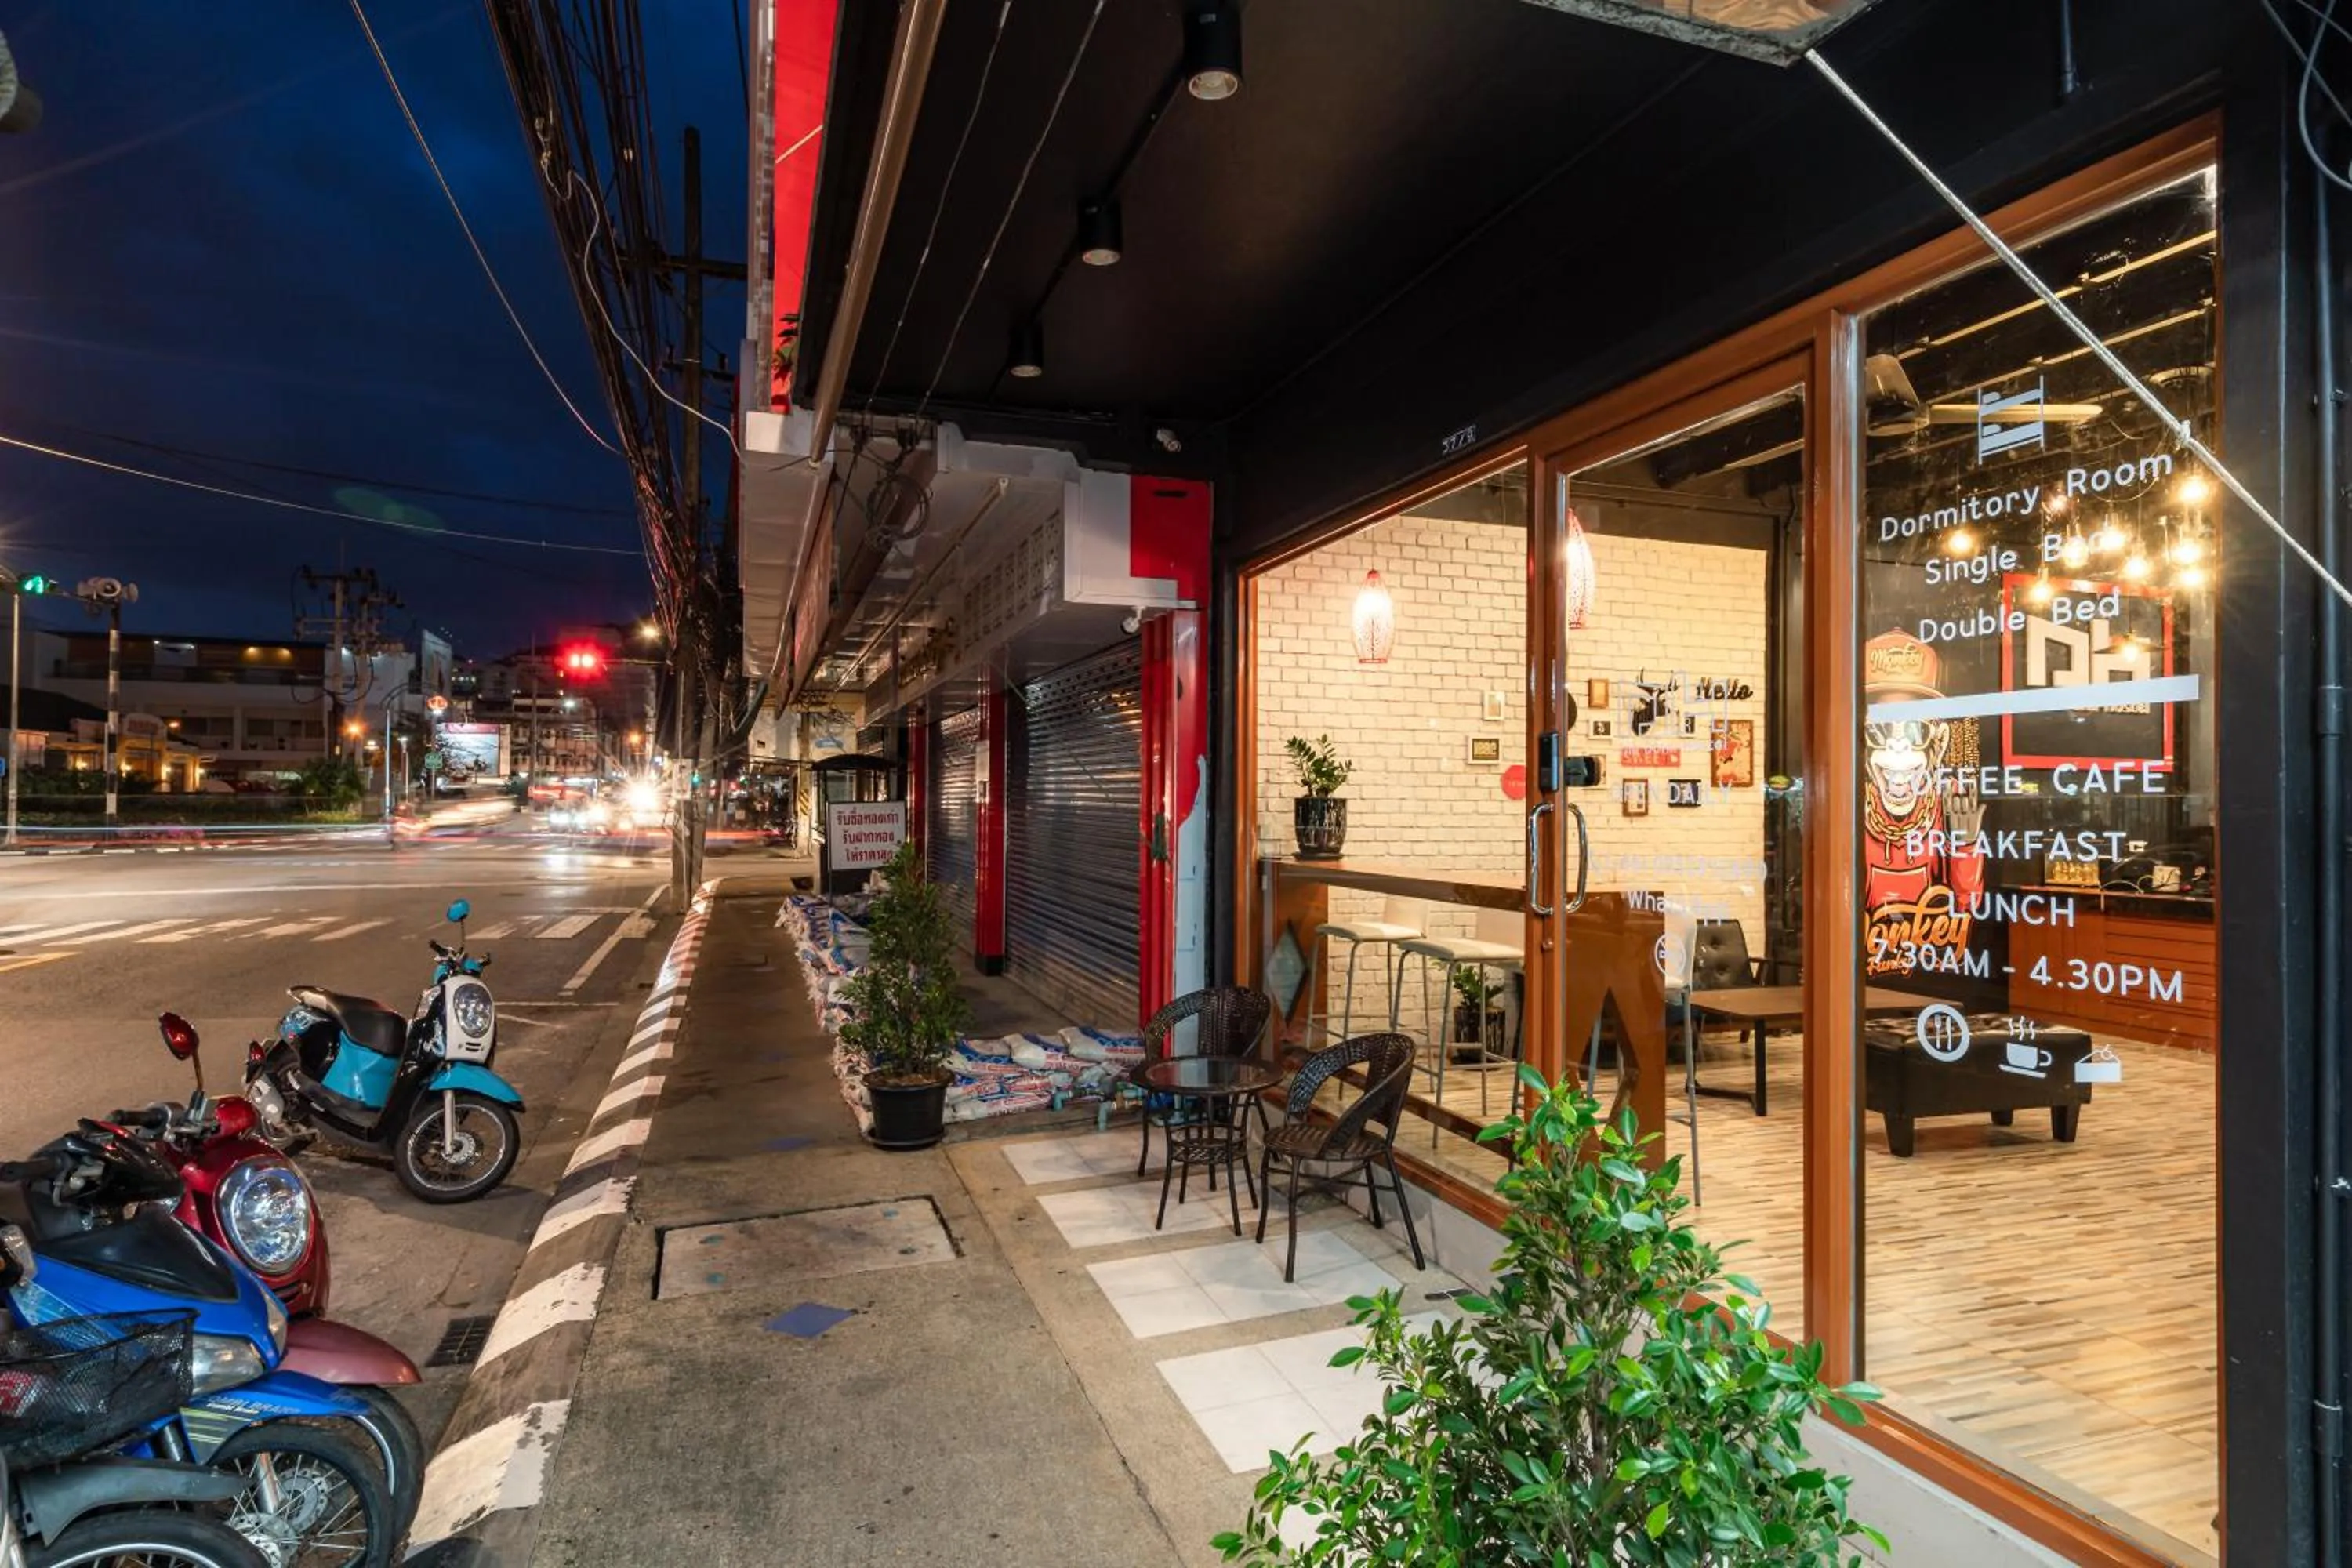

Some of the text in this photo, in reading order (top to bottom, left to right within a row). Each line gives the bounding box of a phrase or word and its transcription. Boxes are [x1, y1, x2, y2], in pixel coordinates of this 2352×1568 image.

[1881, 454, 2172, 541] Dormitory Room
[1925, 546, 2018, 585] Single
[1919, 586, 2120, 643] Double Bed
[1910, 760, 2166, 797] OFFEE CAFE
[1905, 830, 2127, 863] BREAKFAST
[1947, 891, 2075, 927] LUNCH
[1873, 938, 1990, 978] 7.30AM
[2030, 956, 2183, 1004] 4.30PM
